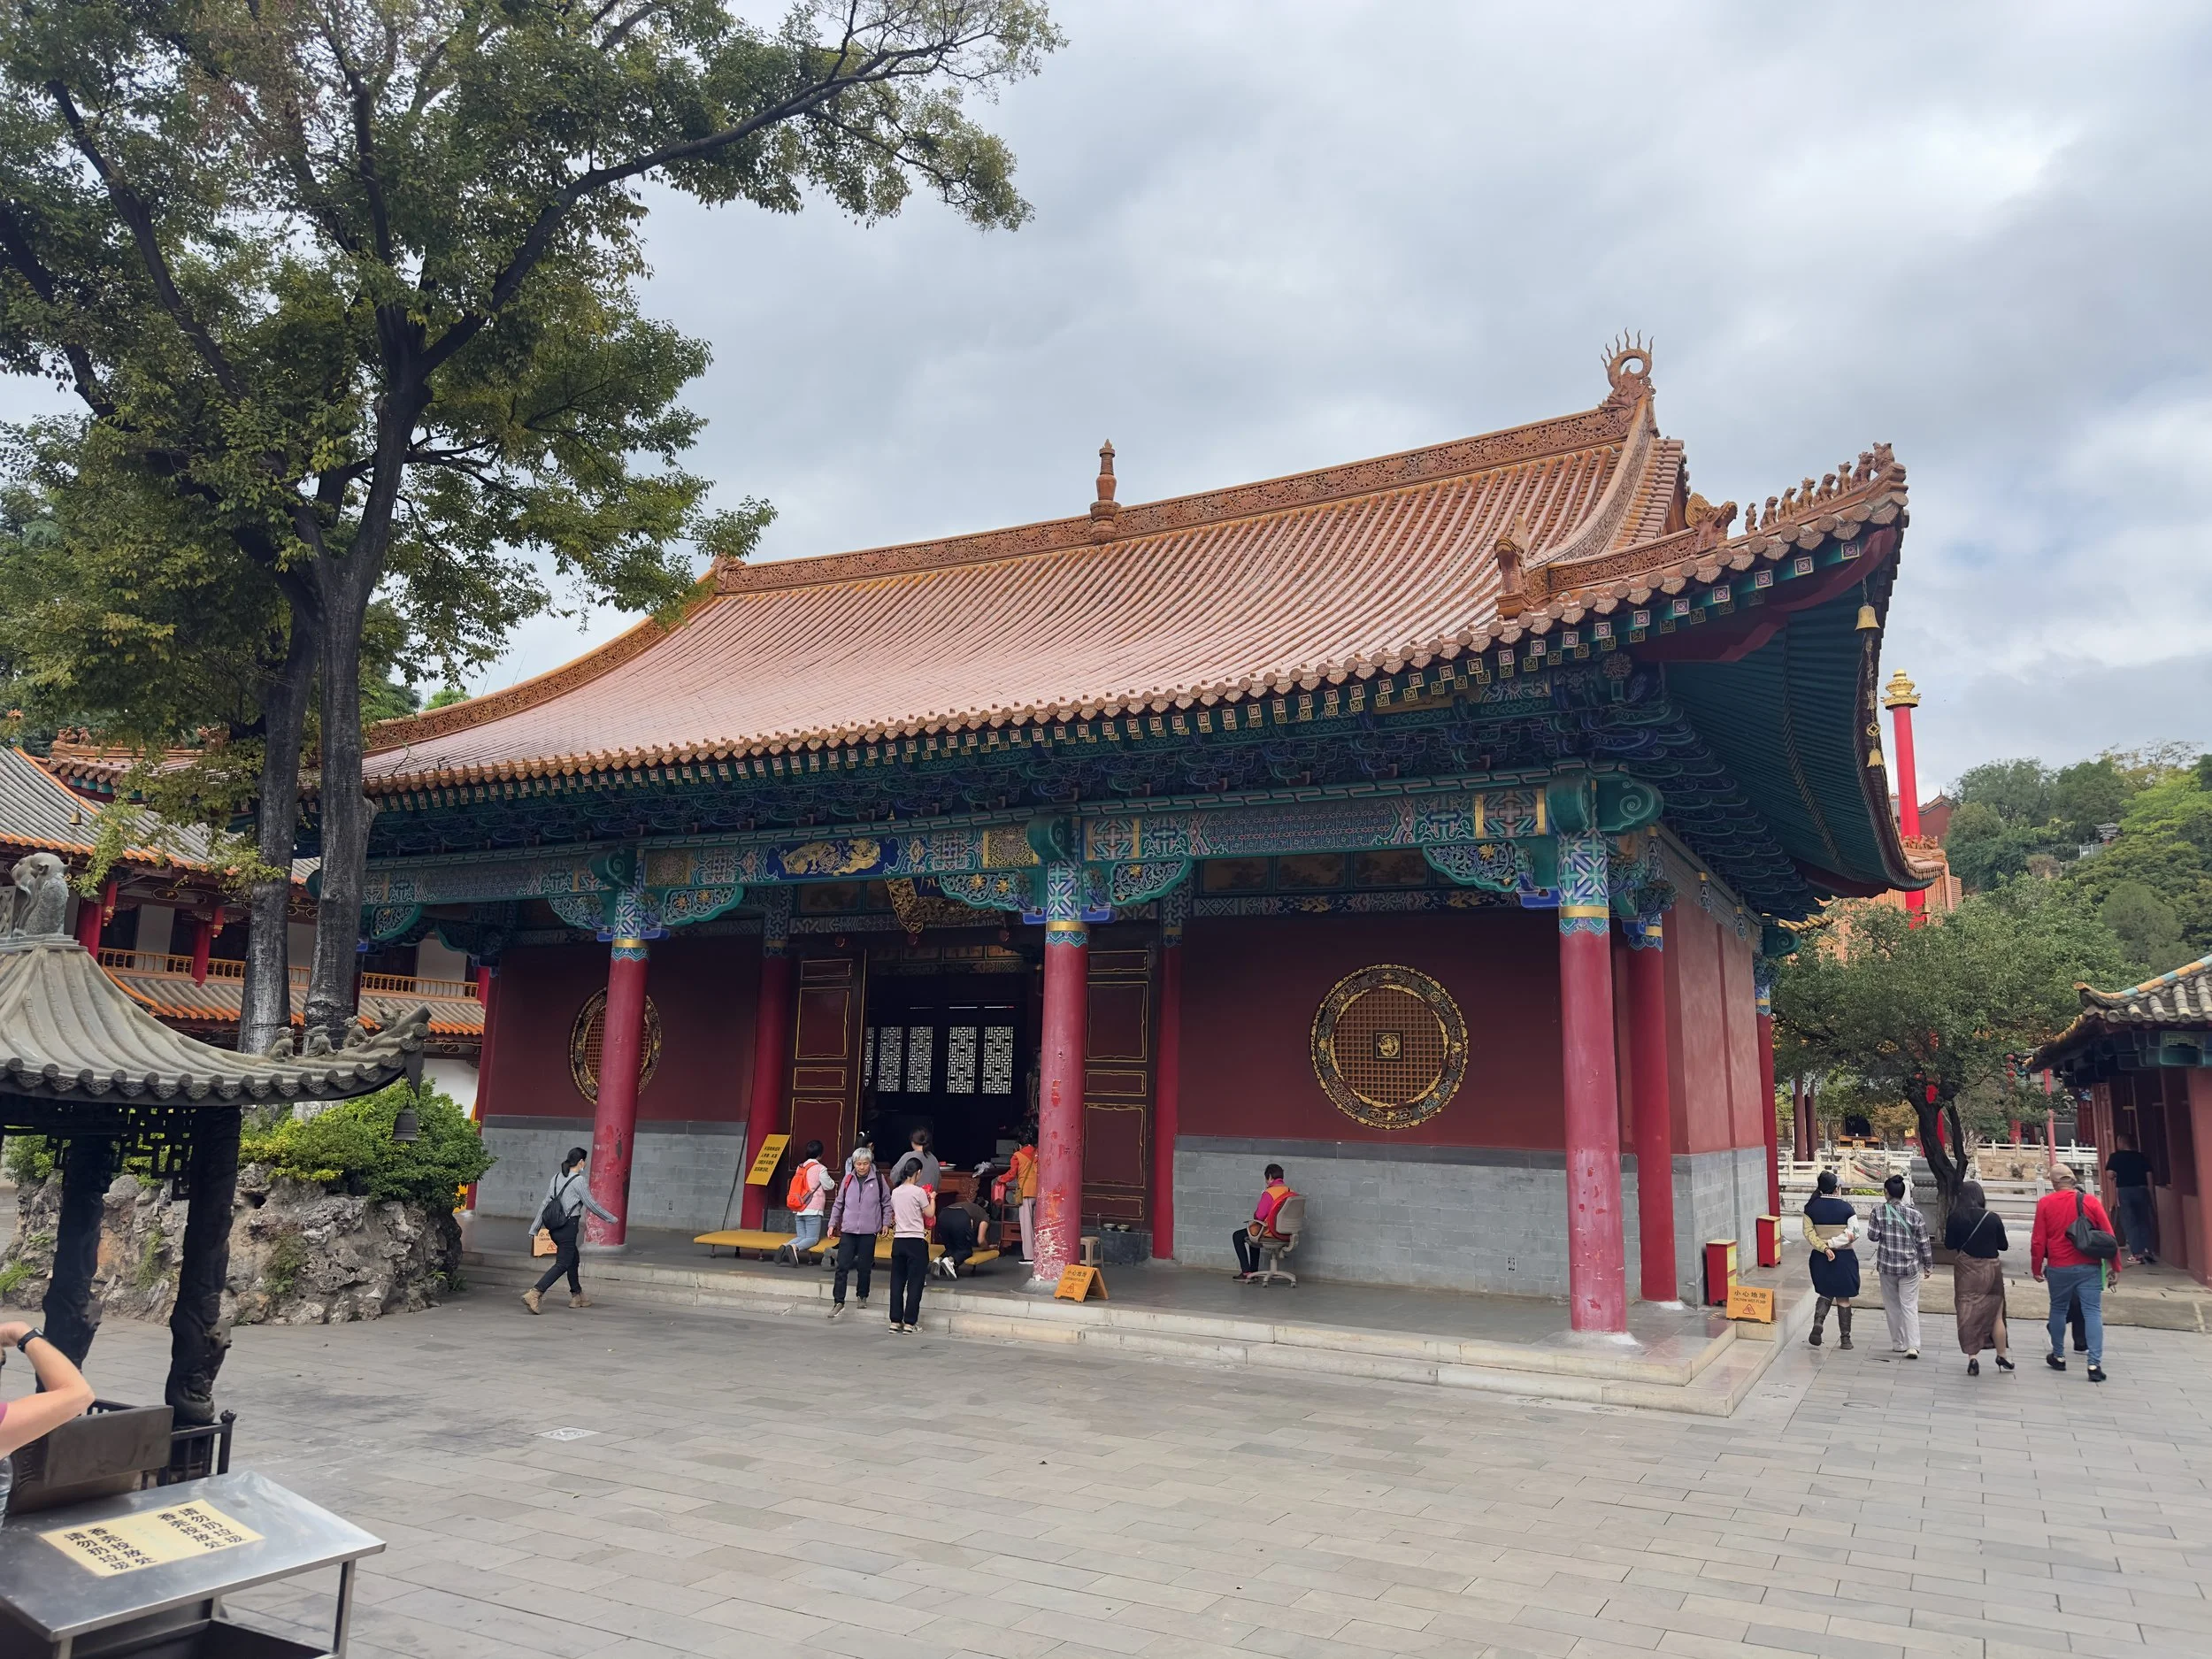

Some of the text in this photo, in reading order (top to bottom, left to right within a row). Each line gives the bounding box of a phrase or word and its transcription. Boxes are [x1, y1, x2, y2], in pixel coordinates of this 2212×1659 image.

[1734, 1289, 1767, 1300] 小心地滑
[178, 1507, 247, 1543] 请勿扔垃圾
[64, 1532, 134, 1571] 请勿扔垃圾
